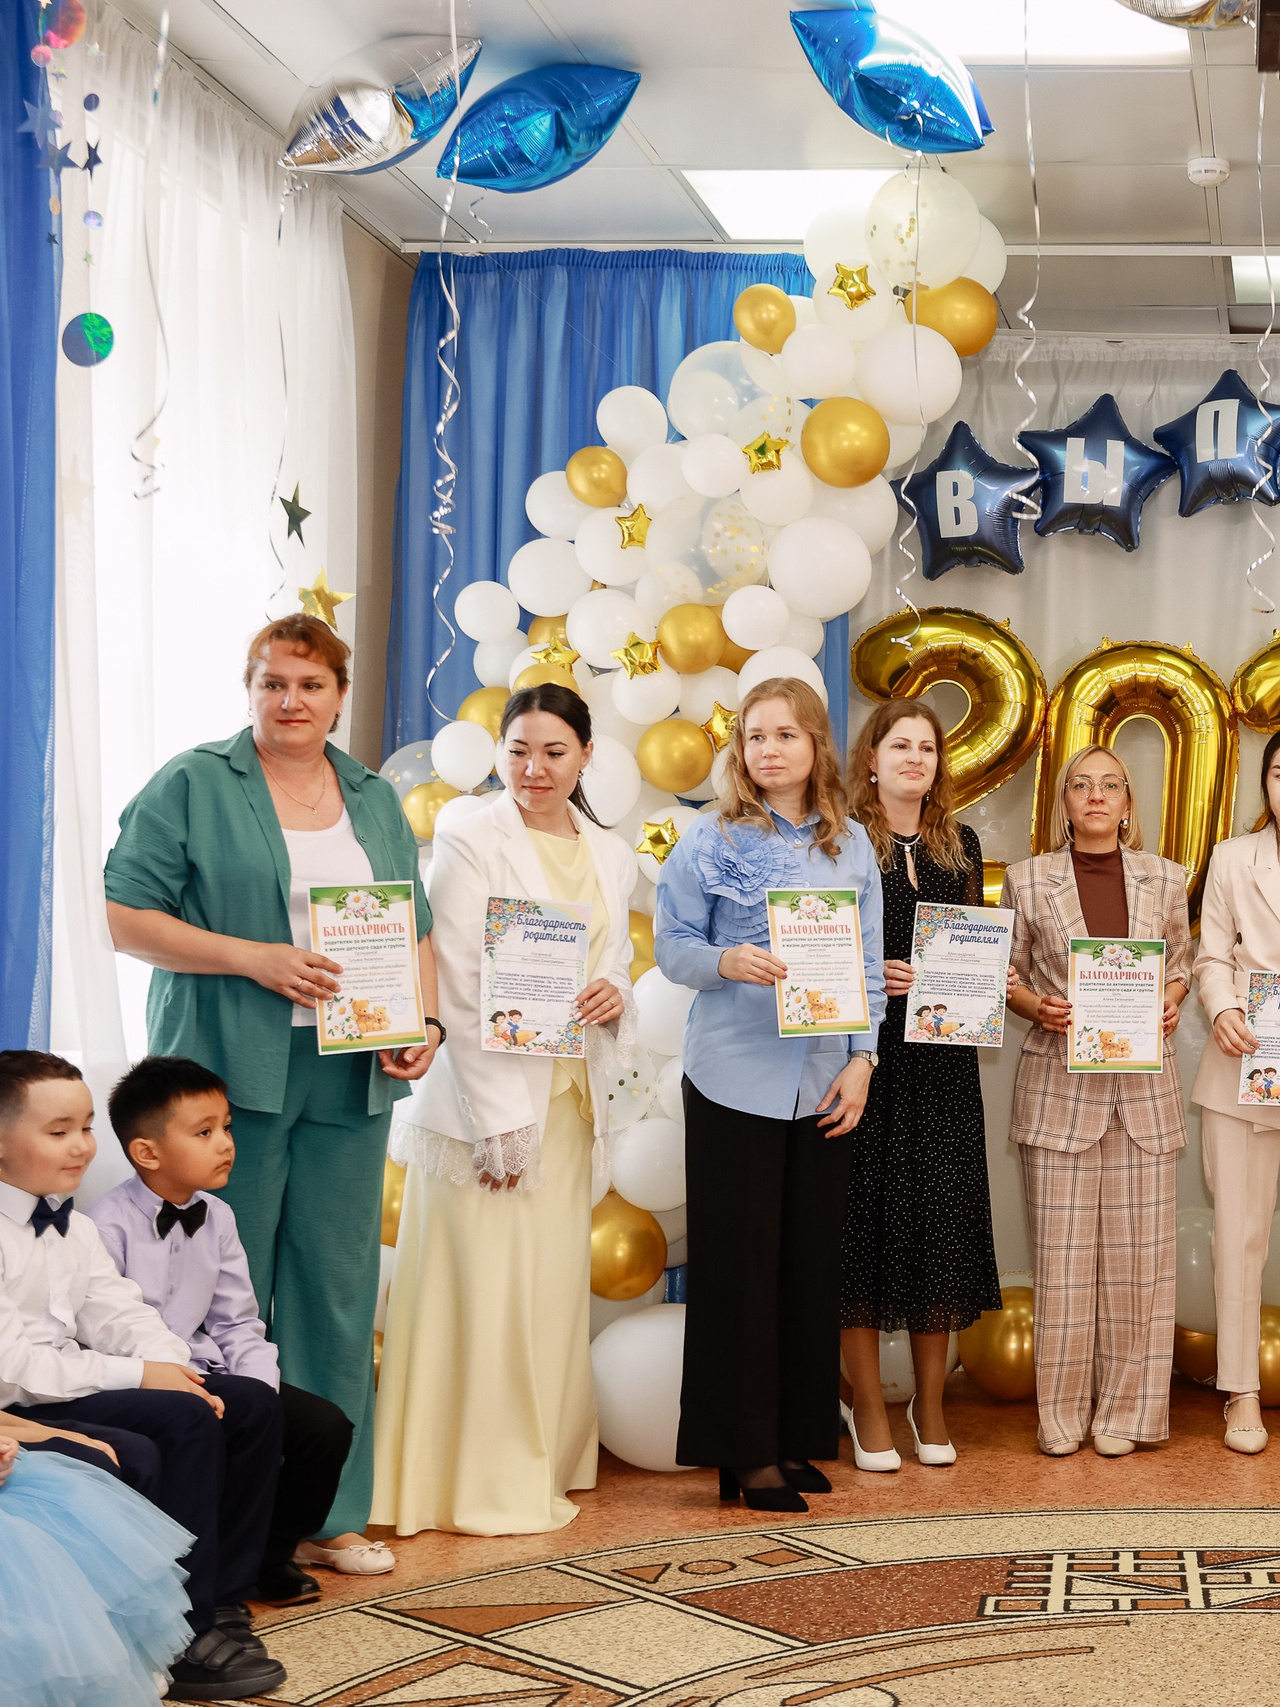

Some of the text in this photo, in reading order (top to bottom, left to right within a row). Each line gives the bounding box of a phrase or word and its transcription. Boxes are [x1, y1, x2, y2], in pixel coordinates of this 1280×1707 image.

[516, 913, 587, 932] Благодарность
[781, 923, 850, 936] БЛАГОДАРНОСТЬ
[943, 919, 1009, 934] Благодарность
[323, 923, 404, 937] БЛАГОДАРНОСТЬ
[523, 929, 577, 943] родителям
[949, 932, 999, 945] родителям
[1080, 971, 1154, 981] БЛАГОДАРНОСТЬ
